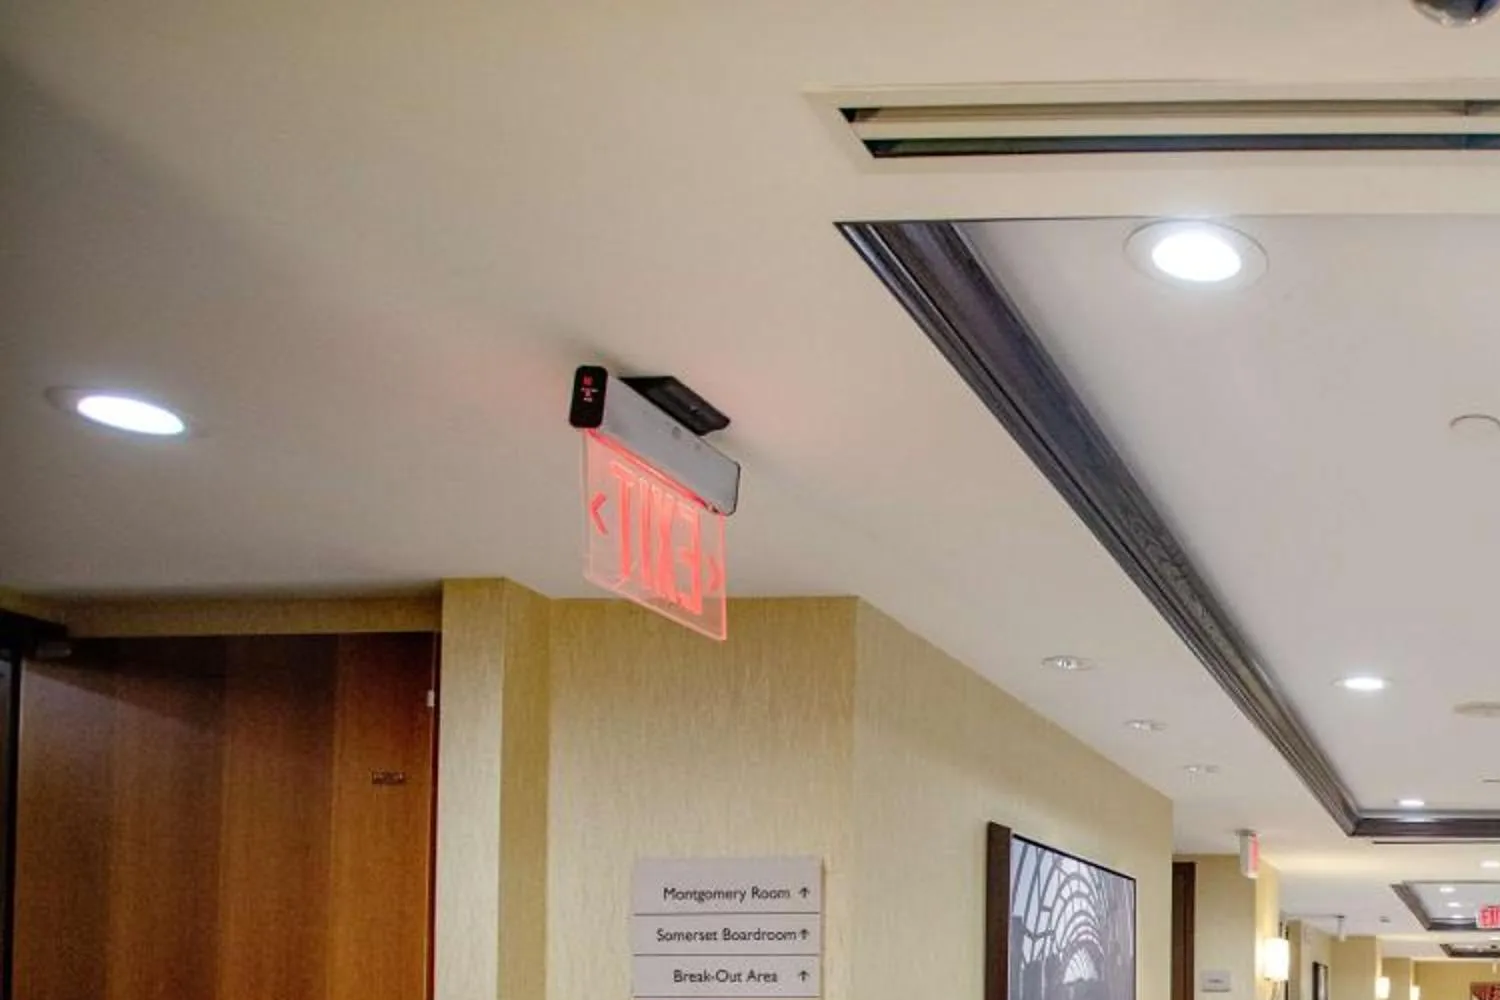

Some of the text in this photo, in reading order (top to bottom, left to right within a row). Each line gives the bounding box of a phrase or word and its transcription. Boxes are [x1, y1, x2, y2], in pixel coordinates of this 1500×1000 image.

[663, 886, 790, 903] Montgomery Room
[656, 927, 796, 942] Somerset Boardroom
[673, 969, 777, 982] Break-Out Area
